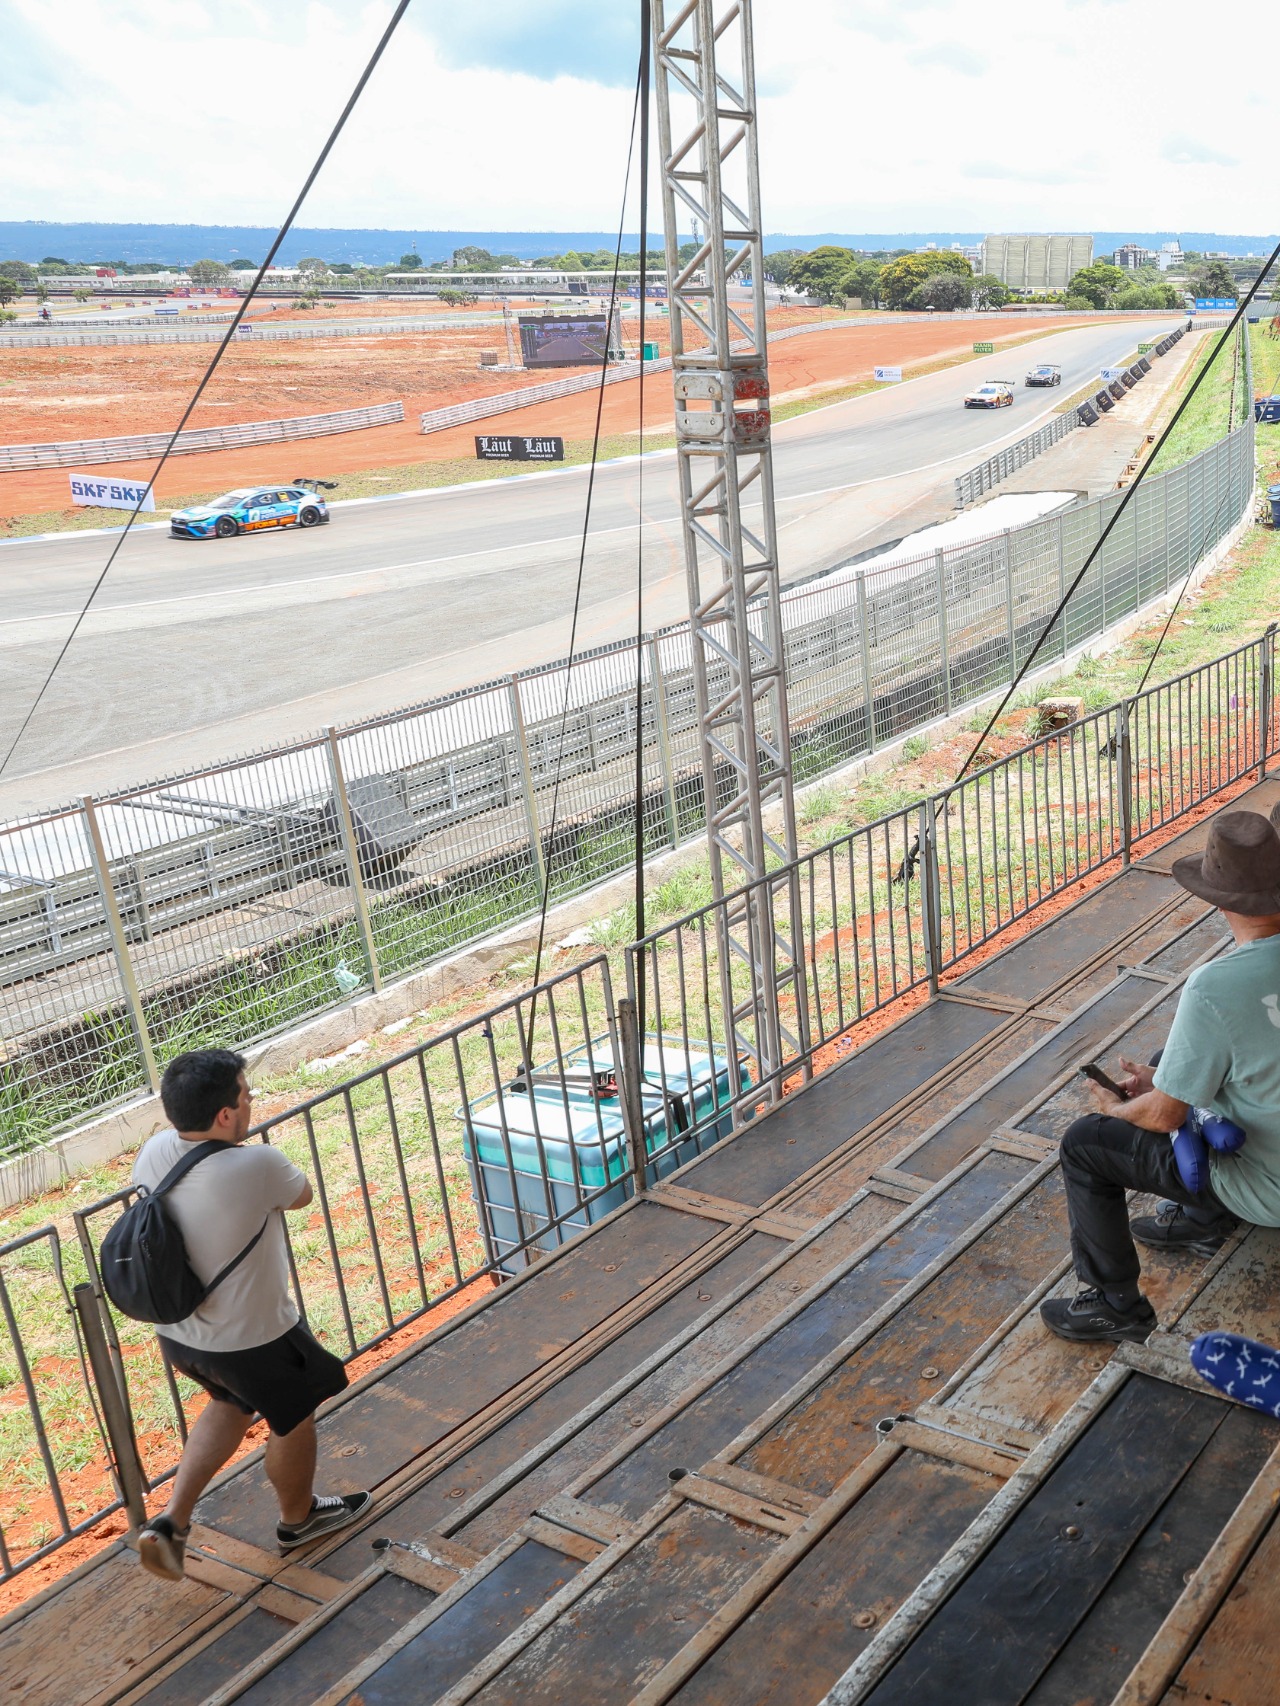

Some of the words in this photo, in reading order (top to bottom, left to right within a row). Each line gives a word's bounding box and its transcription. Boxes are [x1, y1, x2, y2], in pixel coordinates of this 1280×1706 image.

[479, 437, 512, 452] Läut
[523, 438, 557, 453] Läut
[72, 482, 107, 498] SKF
